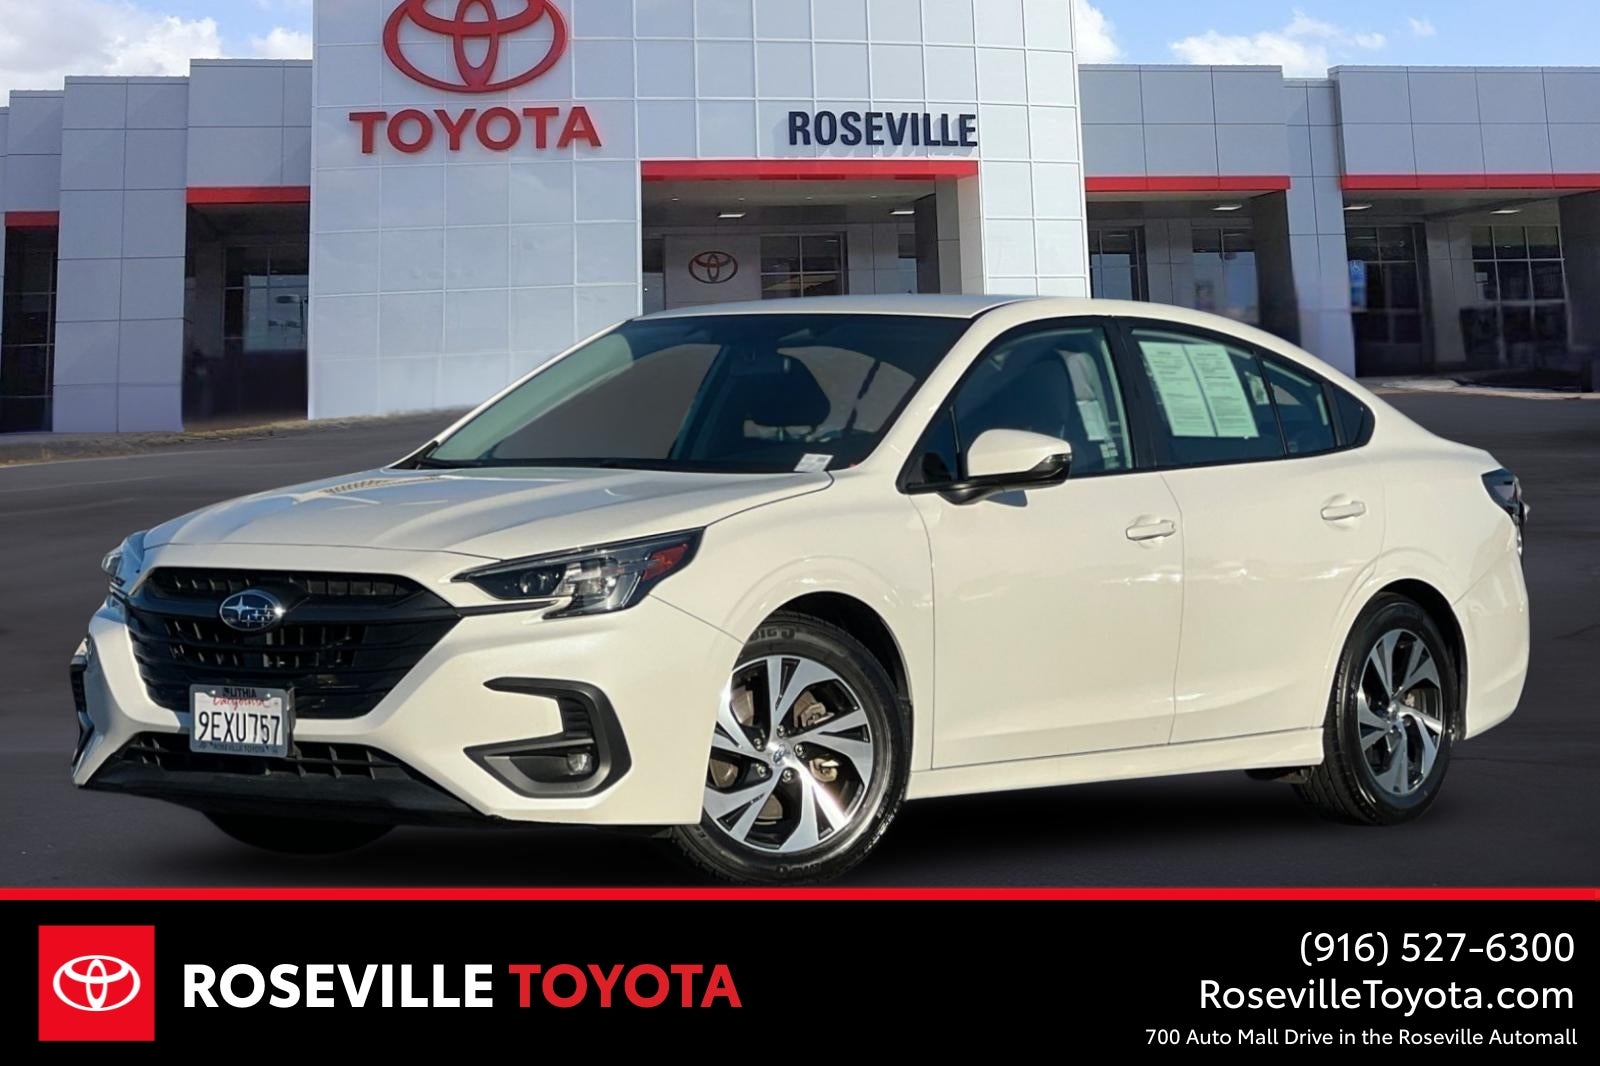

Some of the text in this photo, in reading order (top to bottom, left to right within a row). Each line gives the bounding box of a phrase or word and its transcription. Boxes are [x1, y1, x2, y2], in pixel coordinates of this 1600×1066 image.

[349, 106, 602, 154] TOYOTA
[788, 111, 978, 147] ROSEVILLE
[199, 711, 280, 746] 9EXU757
